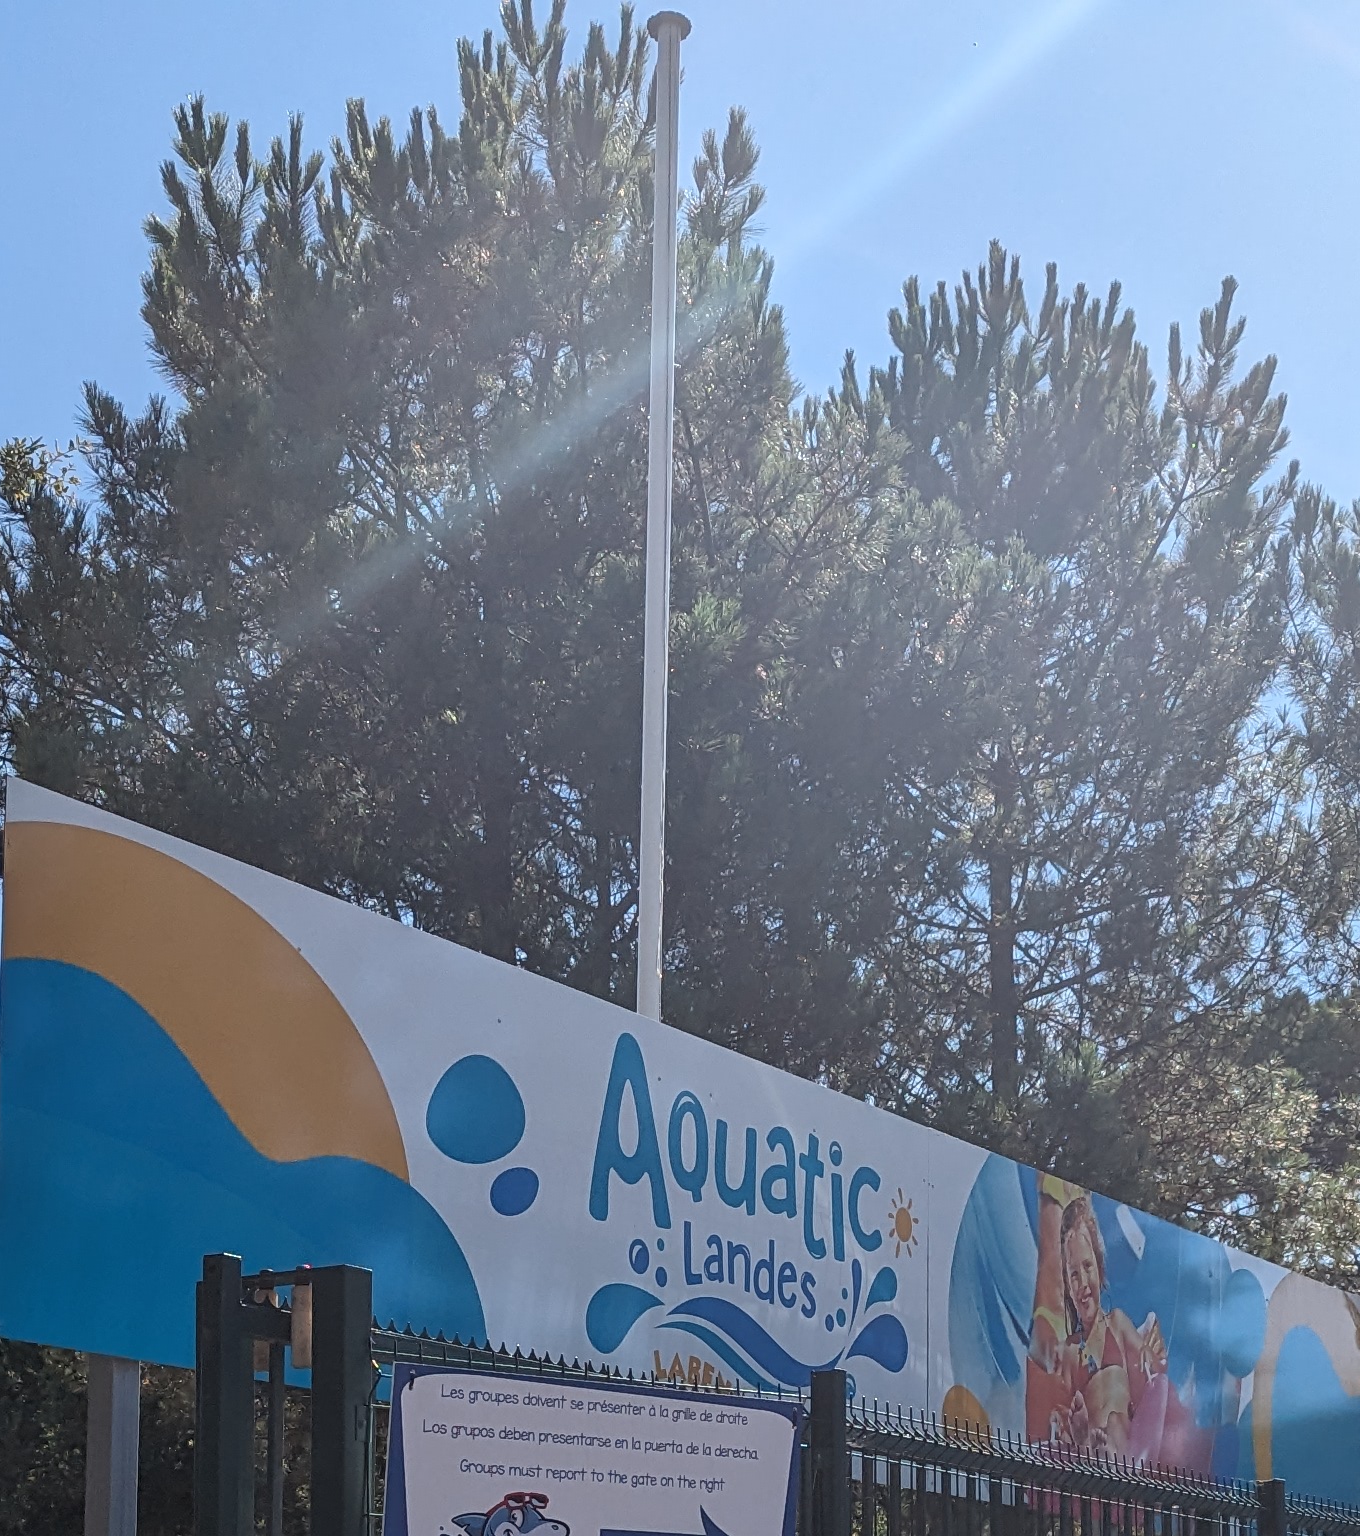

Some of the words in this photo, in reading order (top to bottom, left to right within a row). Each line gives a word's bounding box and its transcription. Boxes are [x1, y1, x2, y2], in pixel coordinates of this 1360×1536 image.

[589, 1032, 881, 1263] Aquatic
[683, 1222, 817, 1317] Landes
[654, 1350, 732, 1388] LABE
[441, 1384, 464, 1400] Les
[468, 1390, 519, 1406] groupes
[522, 1392, 567, 1409] doivent
[570, 1399, 584, 1410] se
[587, 1399, 646, 1416] présenter
[648, 1405, 656, 1417] à
[660, 1405, 668, 1418] la
[672, 1408, 696, 1422] grille
[700, 1408, 712, 1422] de
[716, 1410, 748, 1426] droite
[423, 1419, 447, 1434] Los
[451, 1425, 495, 1440] grupos
[499, 1426, 535, 1442] deben
[538, 1432, 612, 1448] presentarse
[614, 1438, 628, 1449] en
[632, 1436, 640, 1450] la
[644, 1440, 682, 1454] puerta
[686, 1442, 699, 1455] de
[702, 1442, 712, 1456] la
[460, 1458, 505, 1478] Groups
[509, 1464, 542, 1478] must
[546, 1467, 587, 1482] report
[590, 1468, 604, 1482] to
[608, 1470, 628, 1484] the
[630, 1472, 657, 1488] gate
[660, 1475, 674, 1487] on
[676, 1474, 696, 1488] the
[700, 1478, 726, 1493] right
